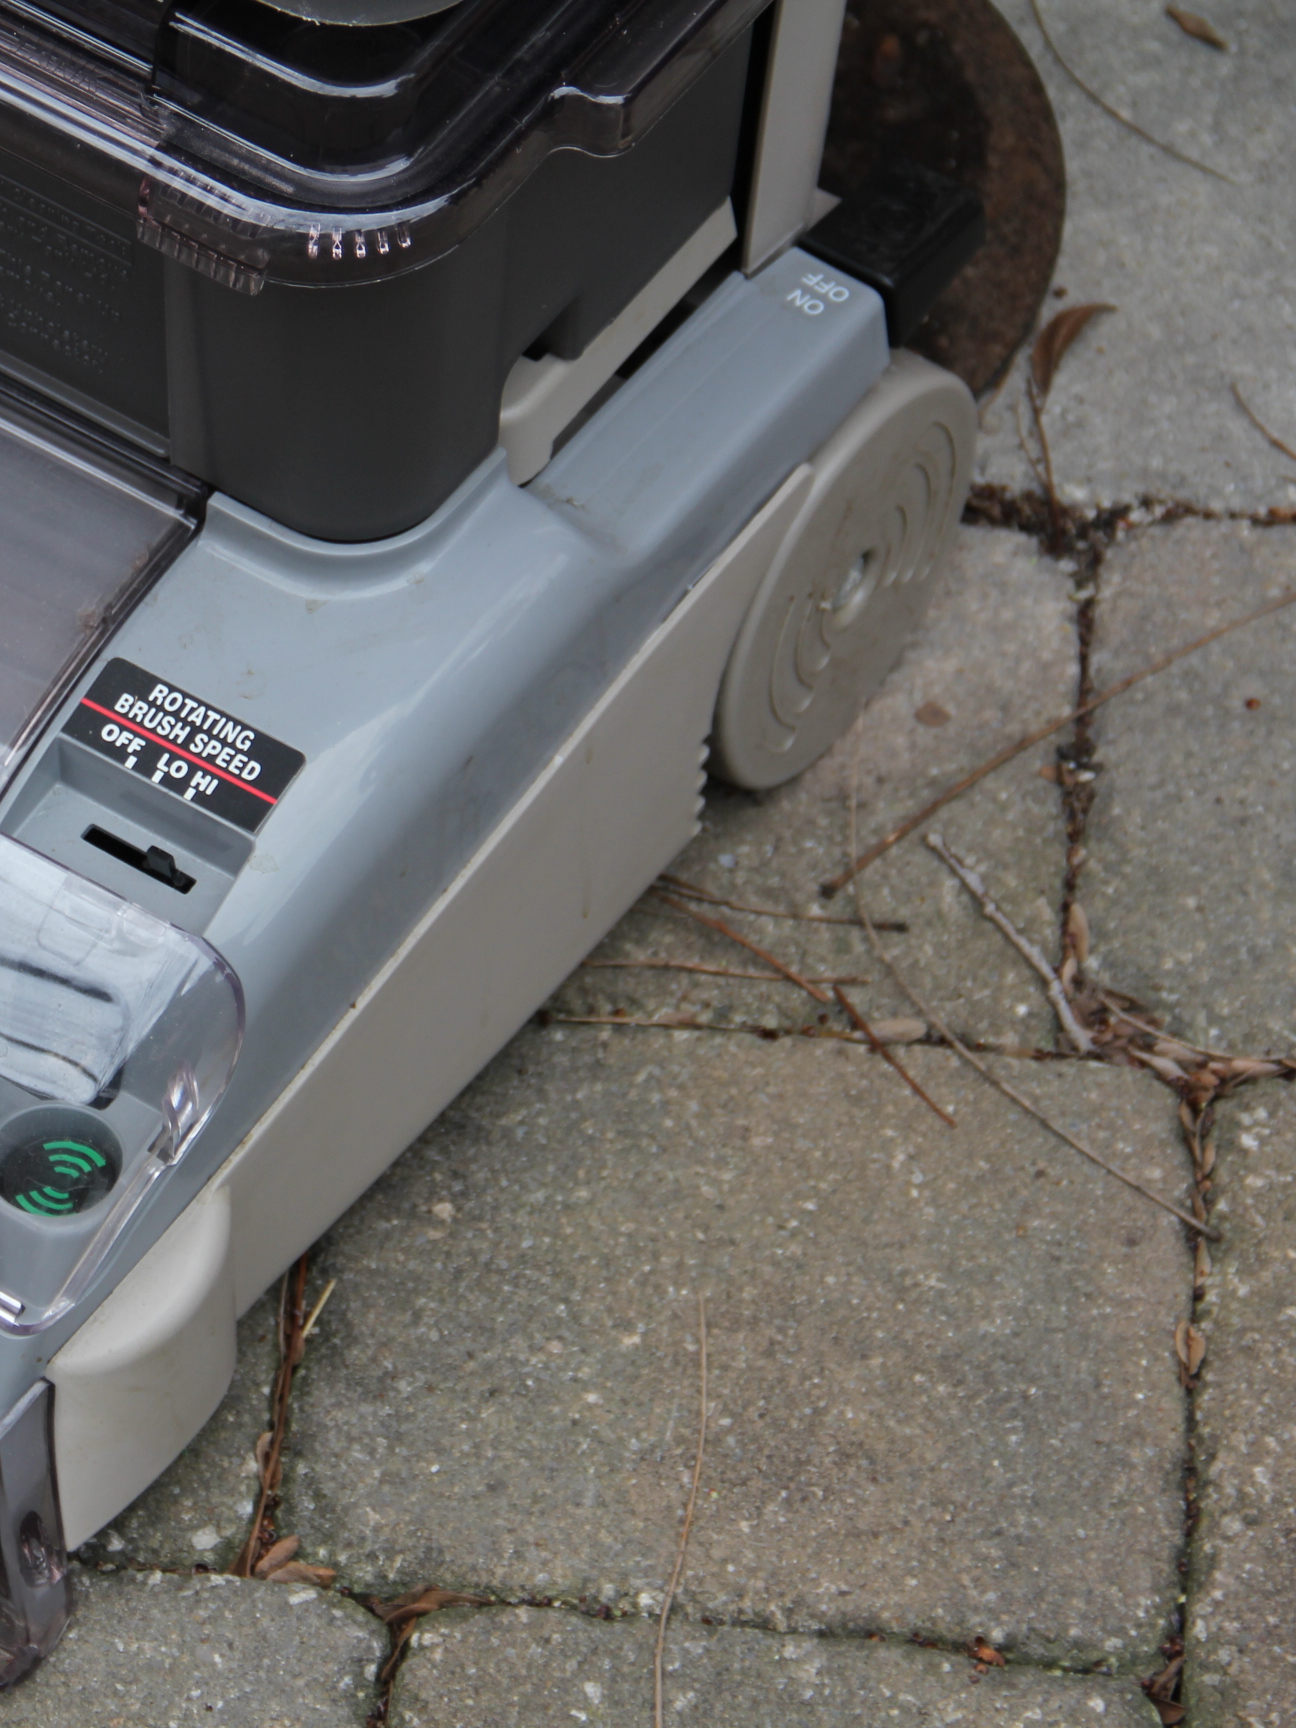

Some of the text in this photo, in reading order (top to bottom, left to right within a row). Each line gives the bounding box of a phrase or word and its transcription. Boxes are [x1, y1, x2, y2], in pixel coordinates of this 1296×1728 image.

[786, 288, 825, 315] ON
[802, 273, 850, 302] OFF
[114, 693, 262, 781] BRUSH SPEED
[148, 684, 255, 751] ROTATING
[101, 723, 219, 795] OFF LO HI
